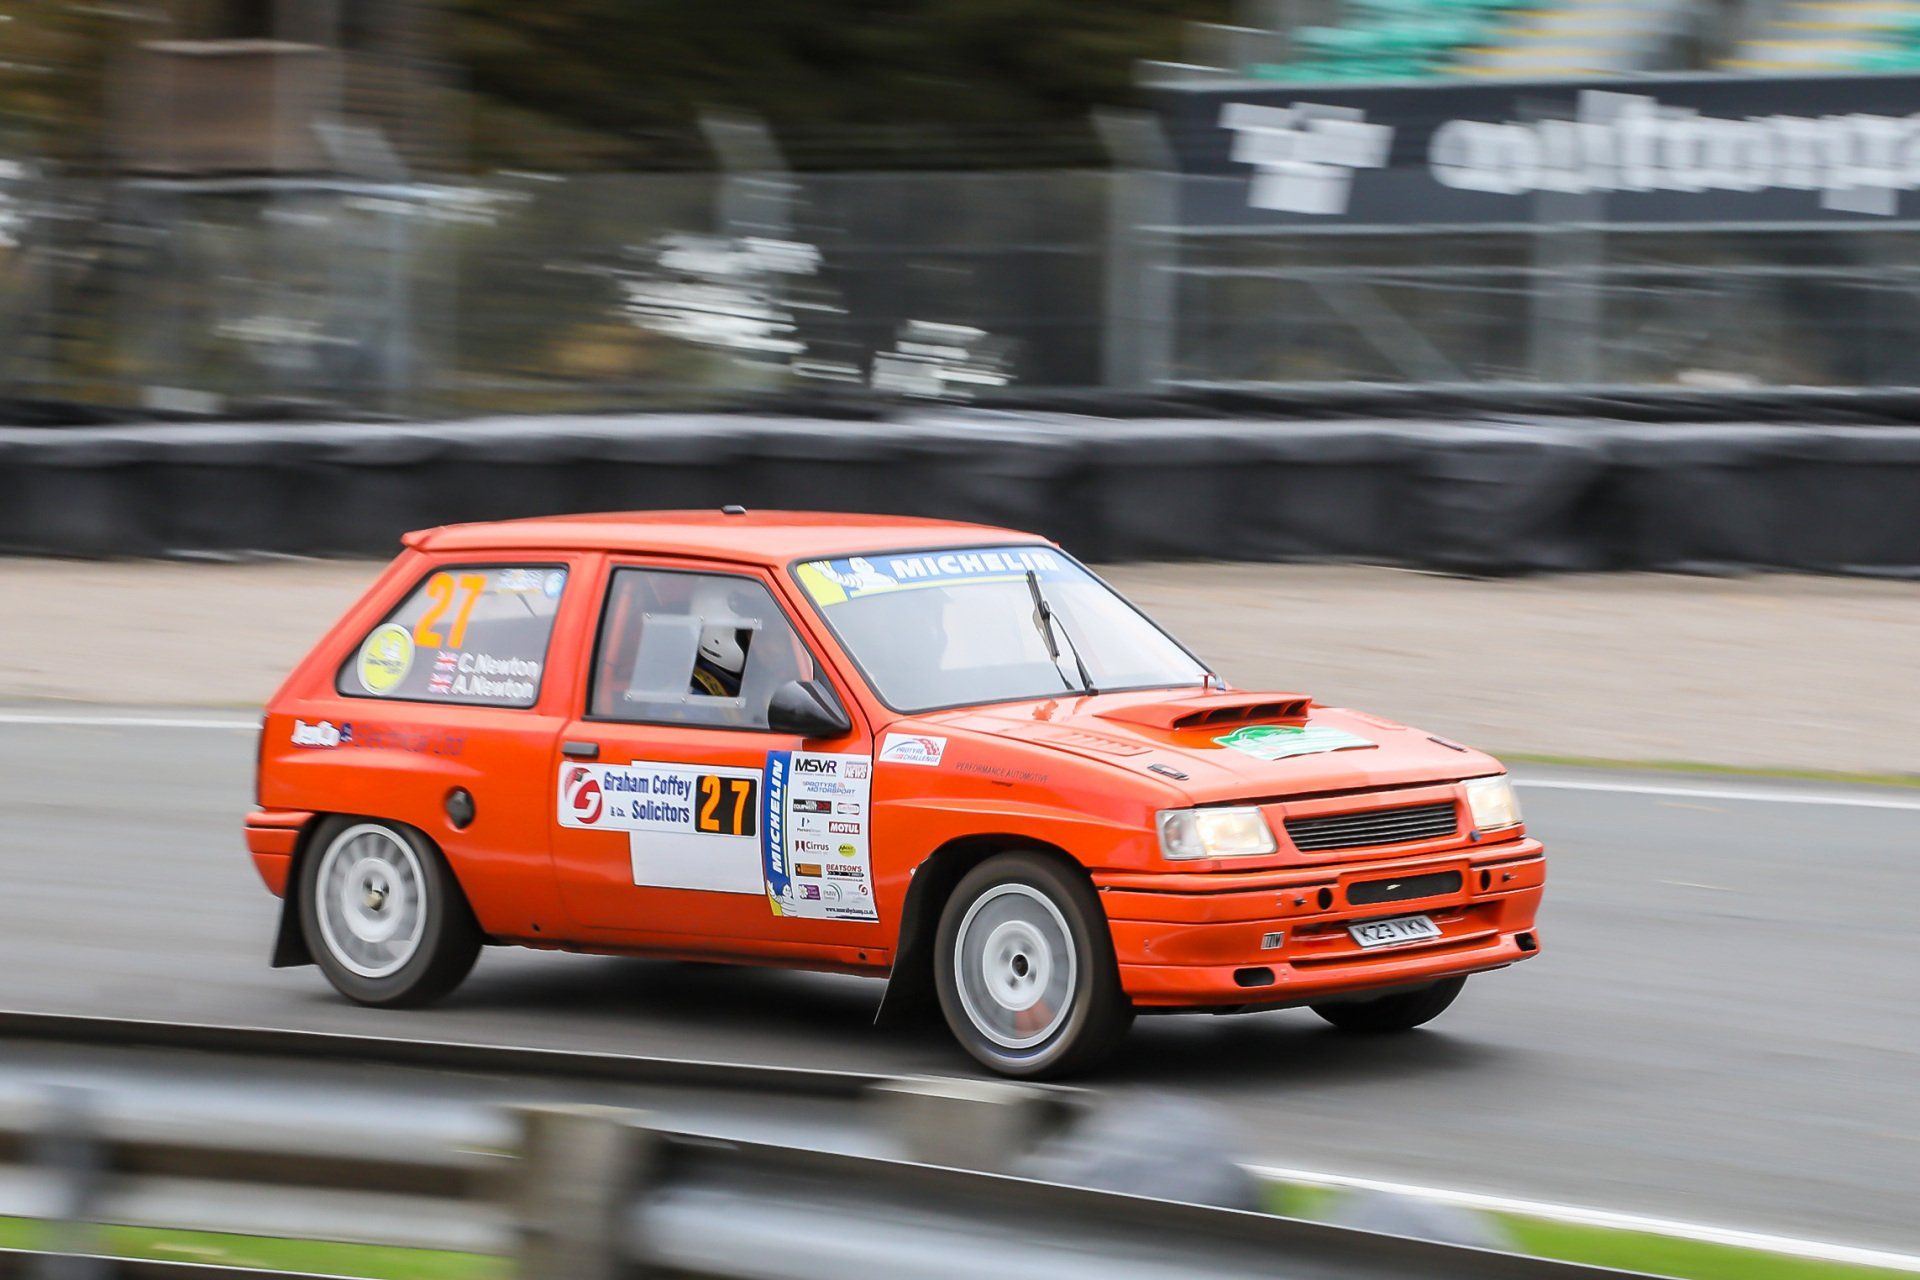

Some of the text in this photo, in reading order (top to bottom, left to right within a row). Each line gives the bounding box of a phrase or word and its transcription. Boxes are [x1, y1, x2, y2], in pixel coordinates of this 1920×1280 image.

[890, 552, 1059, 579] MICHELIN
[413, 572, 488, 649] 27
[795, 758, 837, 773] MSVR
[956, 761, 1048, 783] PERFORMANCE AUTOMOTIVE
[604, 771, 692, 801] Graham Coffey
[632, 800, 690, 823] Solicitors
[701, 774, 750, 835] 27
[770, 760, 784, 875] MICHELIN
[830, 822, 859, 833] MOTUL
[806, 841, 830, 851] Cirrus
[826, 863, 862, 873] BEATSON'S
[1355, 923, 1395, 942] K23
